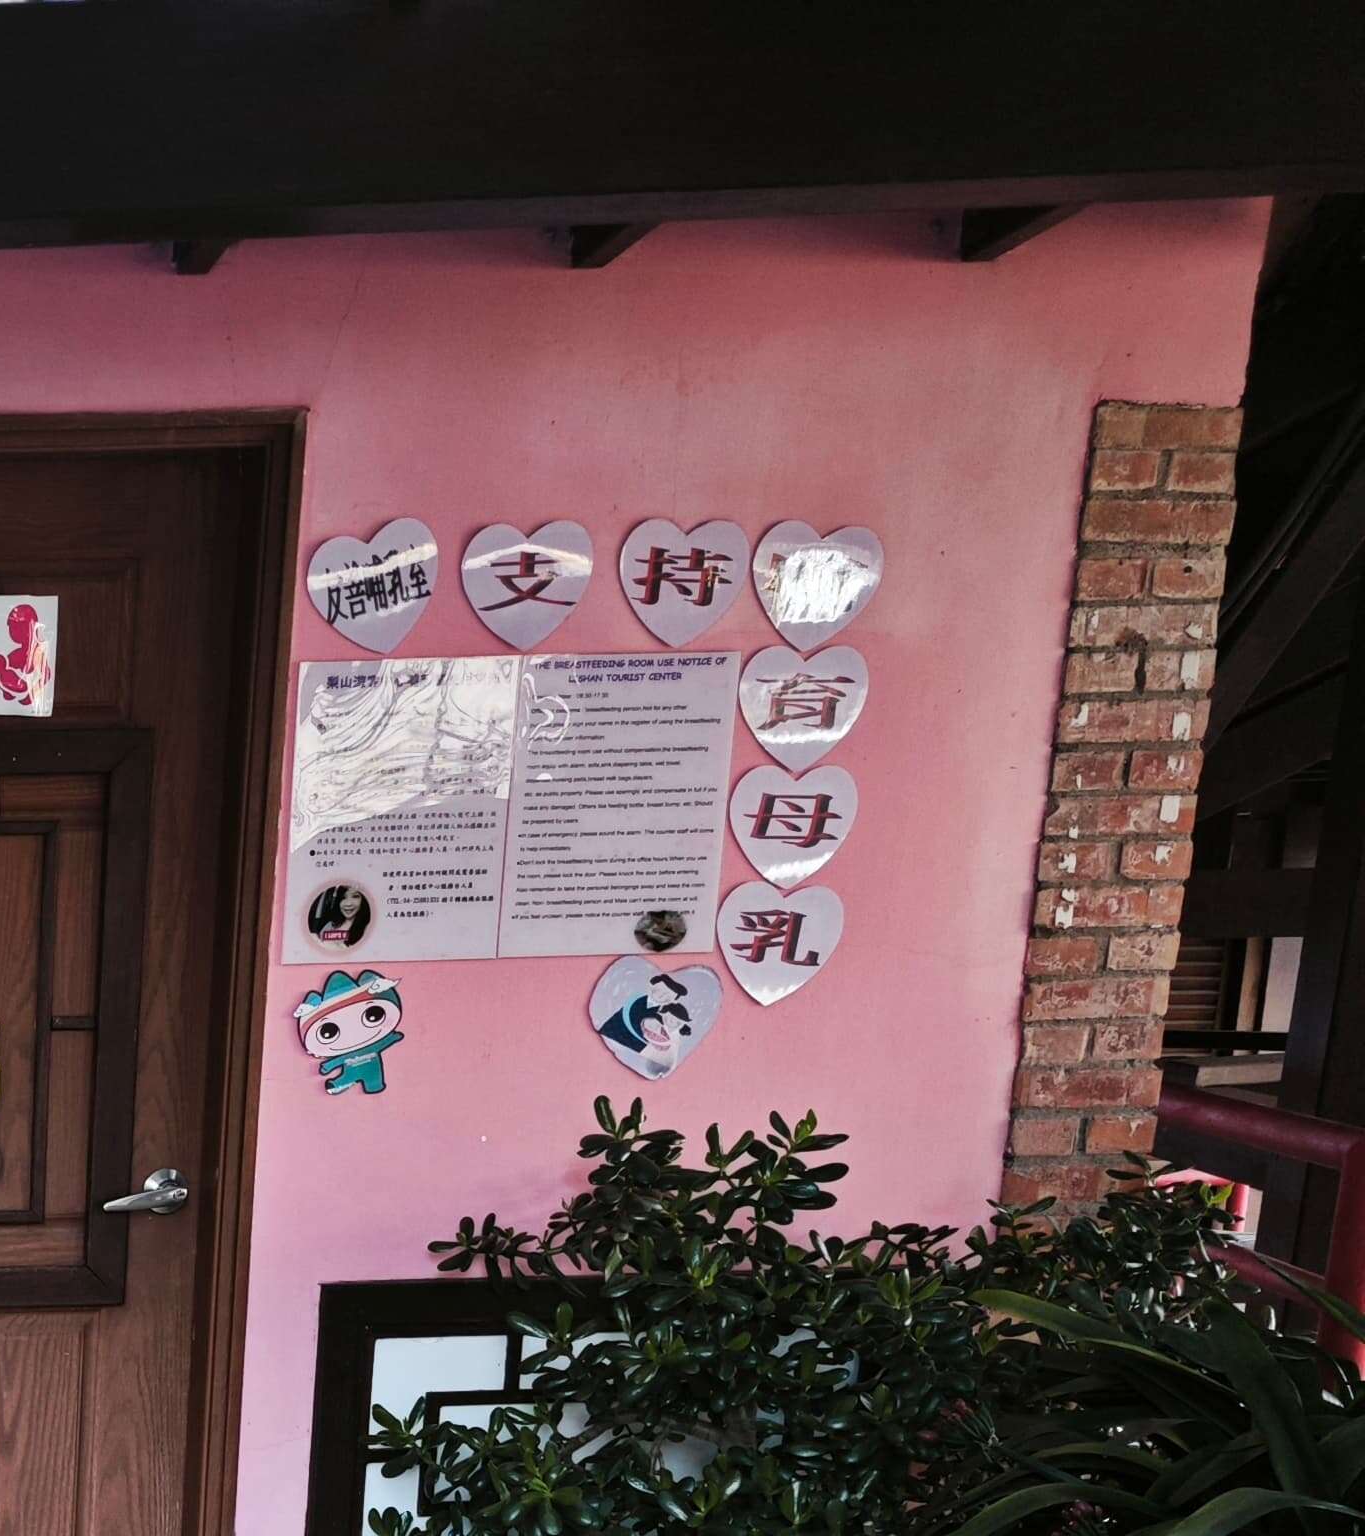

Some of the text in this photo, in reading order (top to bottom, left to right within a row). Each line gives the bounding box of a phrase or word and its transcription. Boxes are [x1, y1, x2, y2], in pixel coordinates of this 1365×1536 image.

[477, 550, 577, 611] 支
[631, 546, 734, 606] 持
[568, 672, 682, 683] LSHAN TOURIST CENTER
[628, 658, 655, 668] ROOM
[657, 658, 675, 666] USE
[677, 657, 712, 666] NOTICE
[715, 656, 728, 666] OF
[756, 673, 856, 730] 育
[743, 792, 840, 848] 母
[732, 908, 820, 967] 乳
